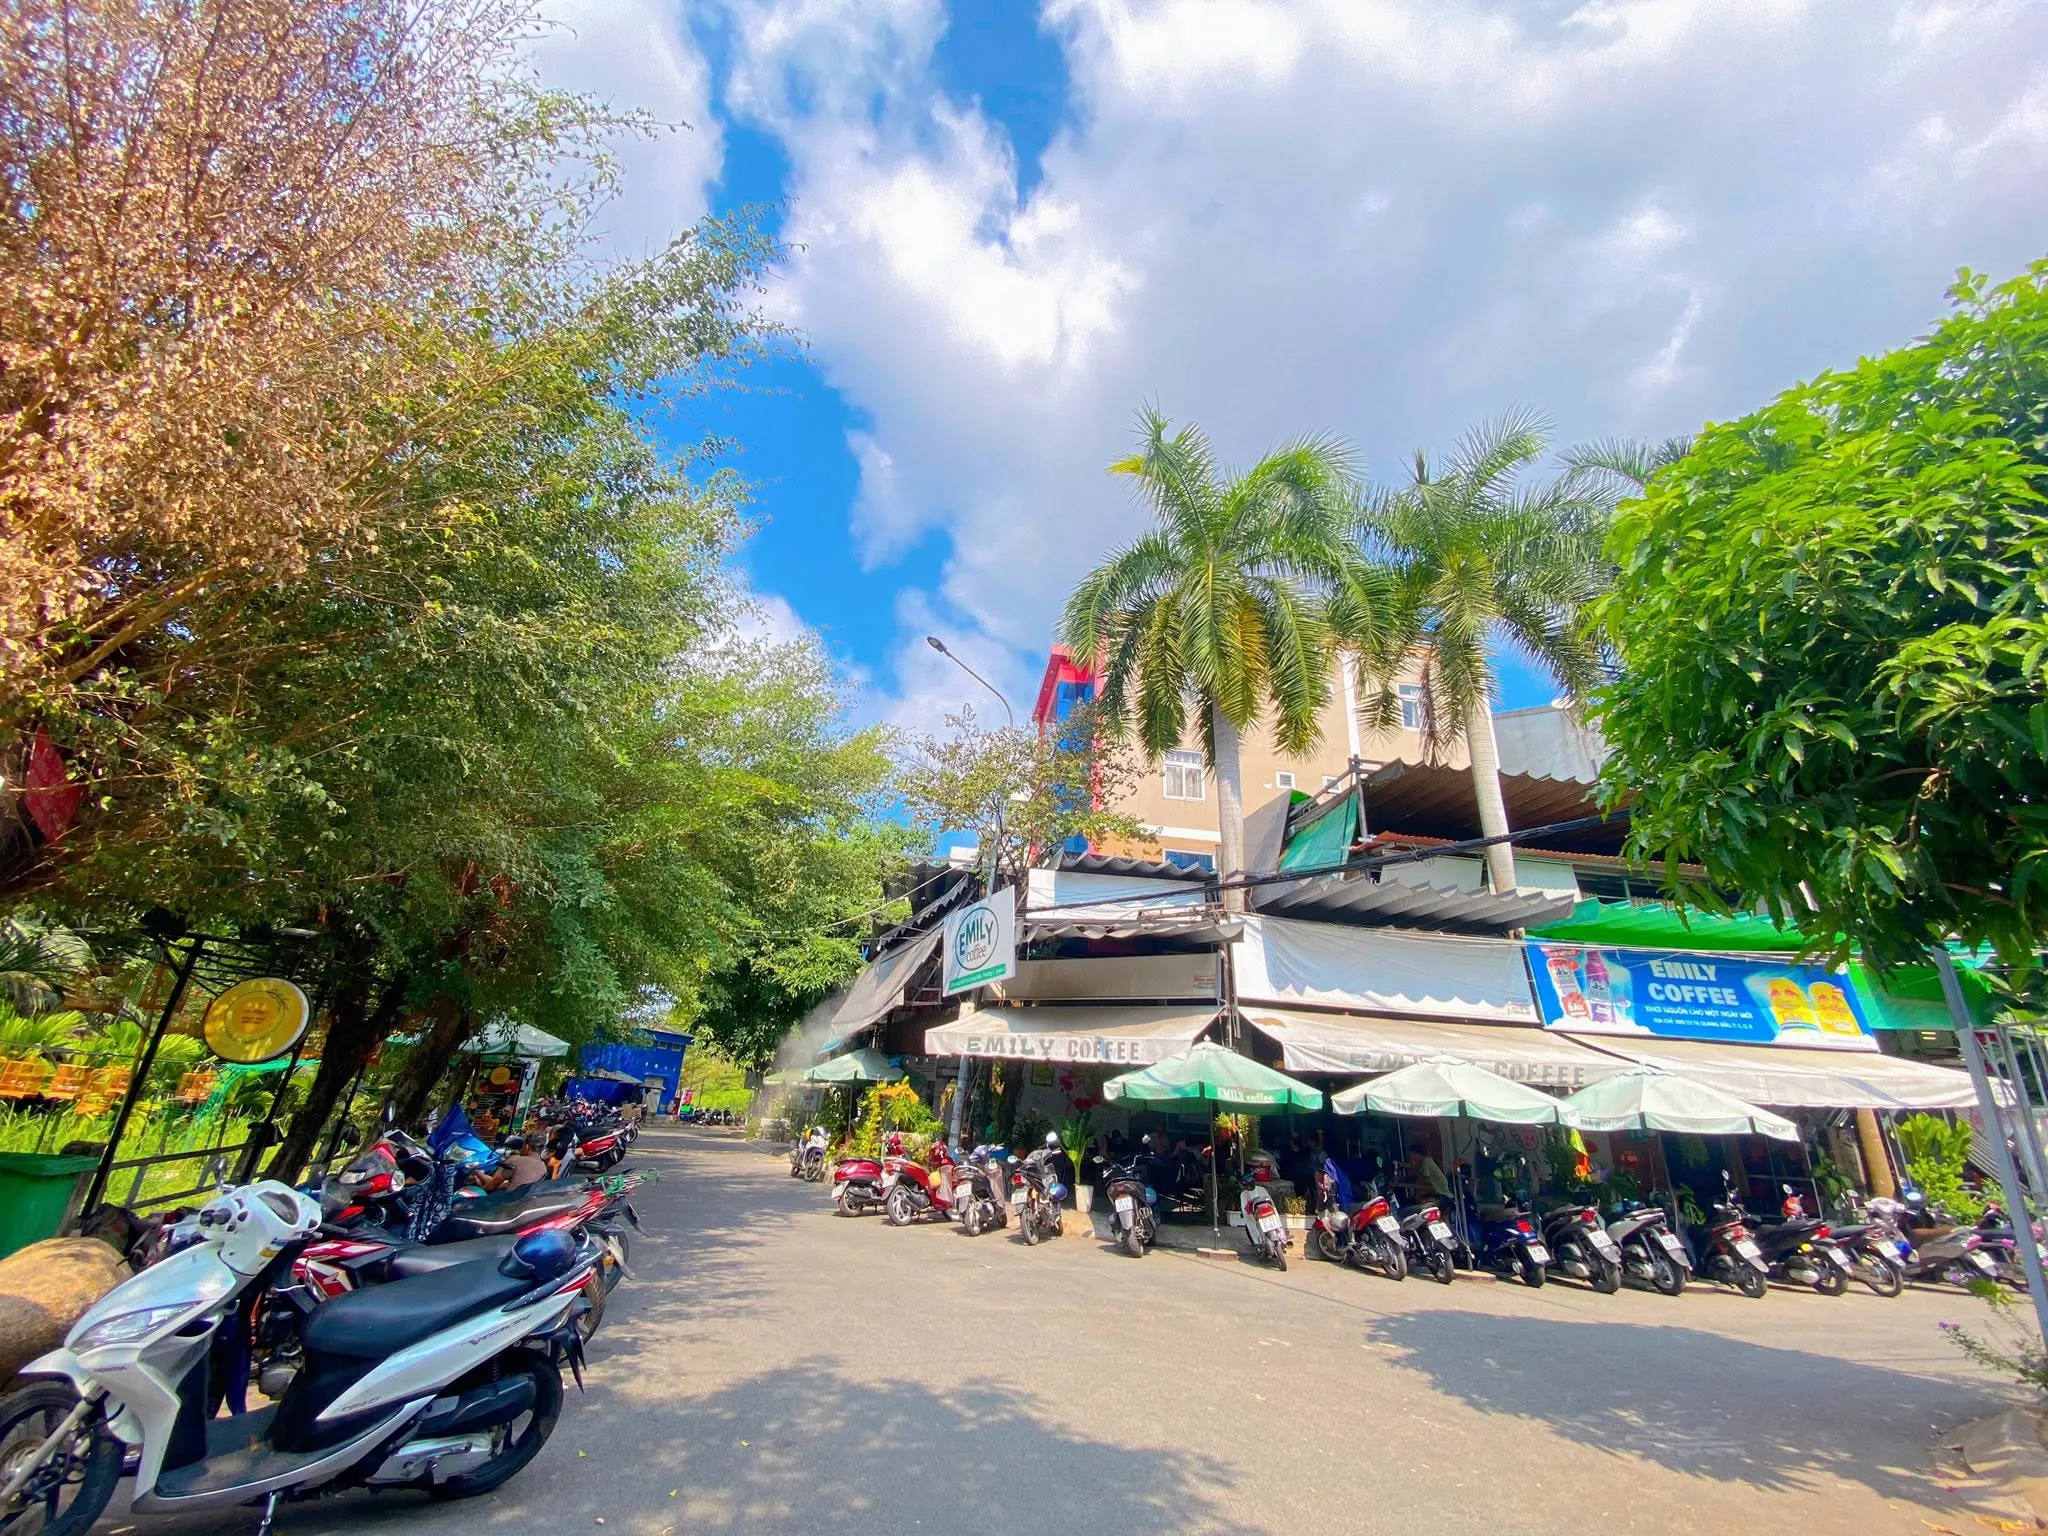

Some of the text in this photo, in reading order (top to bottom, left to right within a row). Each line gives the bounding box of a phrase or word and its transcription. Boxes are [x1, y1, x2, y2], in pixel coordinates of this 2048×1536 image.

[959, 917, 994, 957] EMILY
[966, 944, 987, 962] coffee
[1649, 960, 1717, 981] EMILY
[1648, 983, 1739, 1006] COFFEE
[1689, 1007, 1704, 1016] CHO
[966, 1036, 1139, 1060] EMILY COFFEE
[1494, 1061, 1585, 1085] COFFEE
[1217, 1086, 1274, 1103] EMILY coffee
